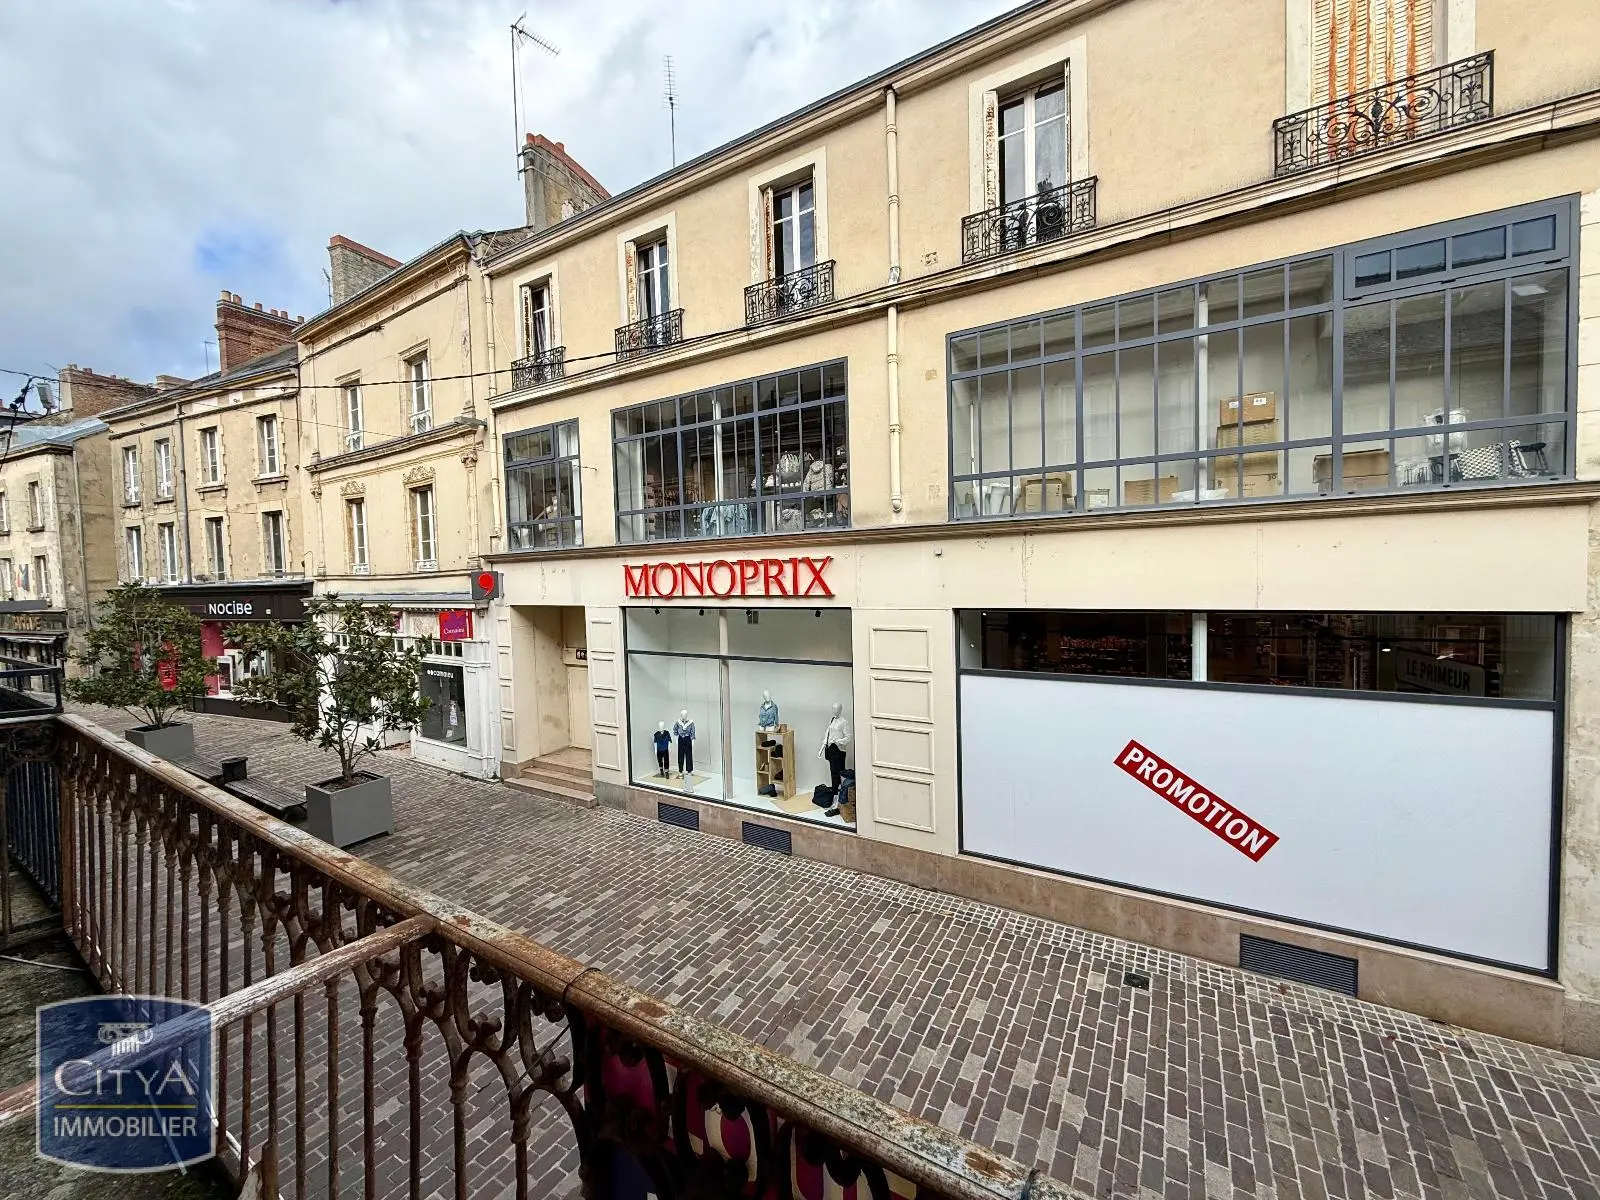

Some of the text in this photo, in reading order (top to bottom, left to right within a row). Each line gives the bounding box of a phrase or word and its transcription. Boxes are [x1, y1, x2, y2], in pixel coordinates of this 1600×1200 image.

[623, 556, 835, 599] MONOPRIX
[1406, 658, 1471, 691] LE PRIMEUR
[1122, 747, 1269, 854] PROMOTION
